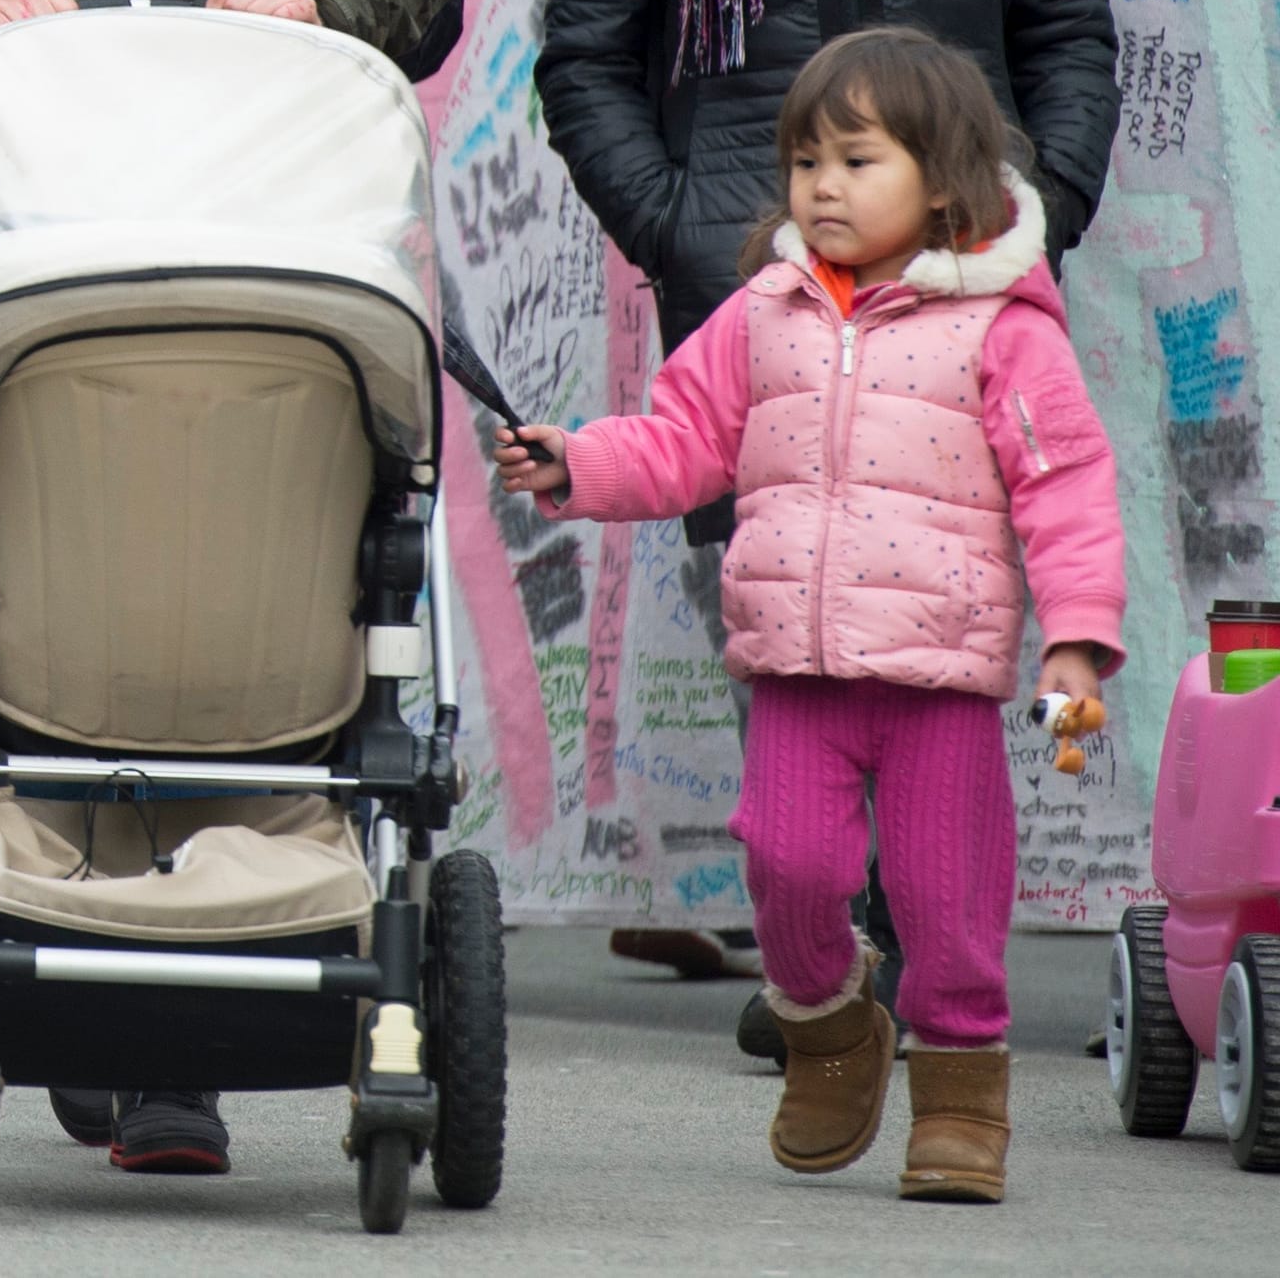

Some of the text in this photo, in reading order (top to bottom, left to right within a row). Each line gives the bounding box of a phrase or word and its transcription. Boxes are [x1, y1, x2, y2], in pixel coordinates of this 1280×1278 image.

[1147, 50, 1175, 160] OUR LAND
[1169, 51, 1202, 155] PROTECT
[540, 670, 588, 710] STAY
[1007, 735, 1057, 768] tand
[1045, 825, 1086, 845] with
[1087, 861, 1140, 881] Britta
[1017, 878, 1087, 903] doctors!
